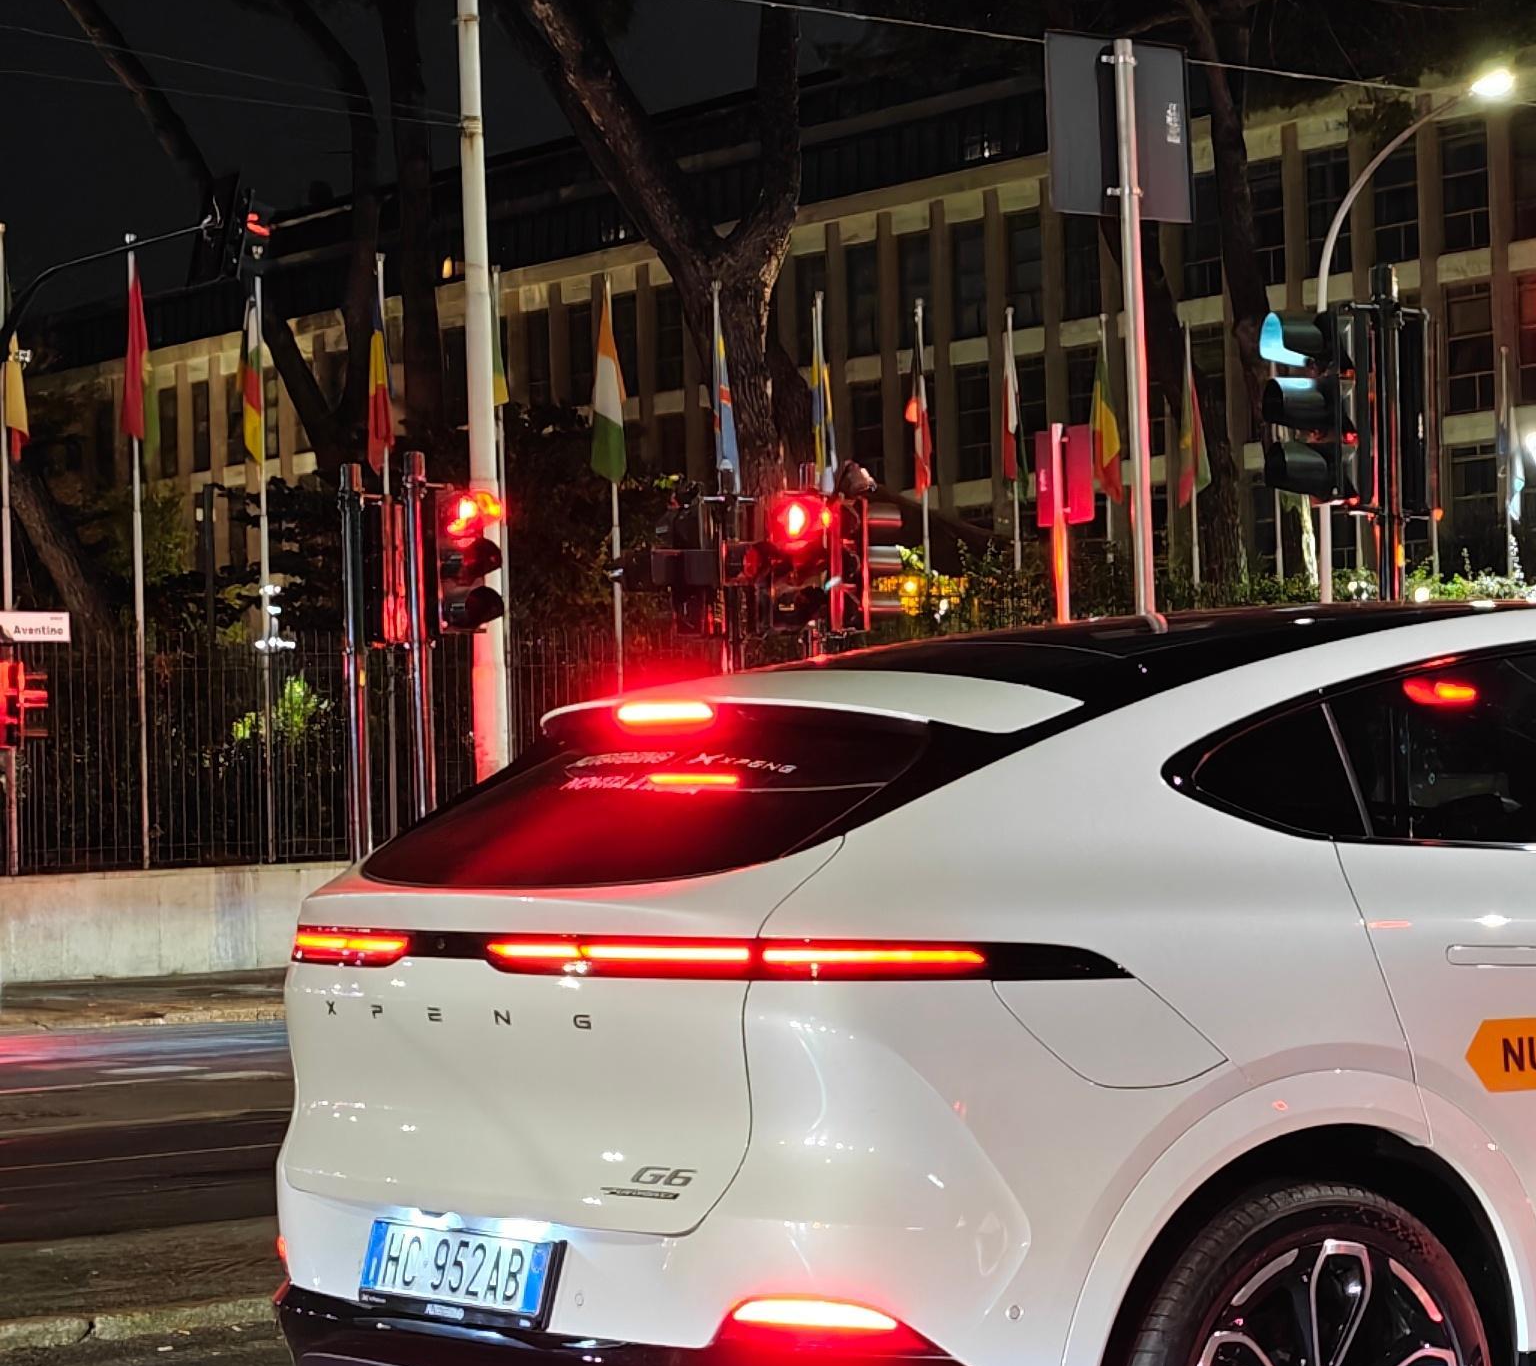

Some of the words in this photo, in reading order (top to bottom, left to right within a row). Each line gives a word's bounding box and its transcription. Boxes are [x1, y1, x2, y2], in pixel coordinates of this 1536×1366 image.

[326, 1001, 592, 1030] XPENG
[630, 1165, 698, 1187] G6
[382, 1232, 422, 1288] HC
[430, 1238, 526, 1303] 952AB
